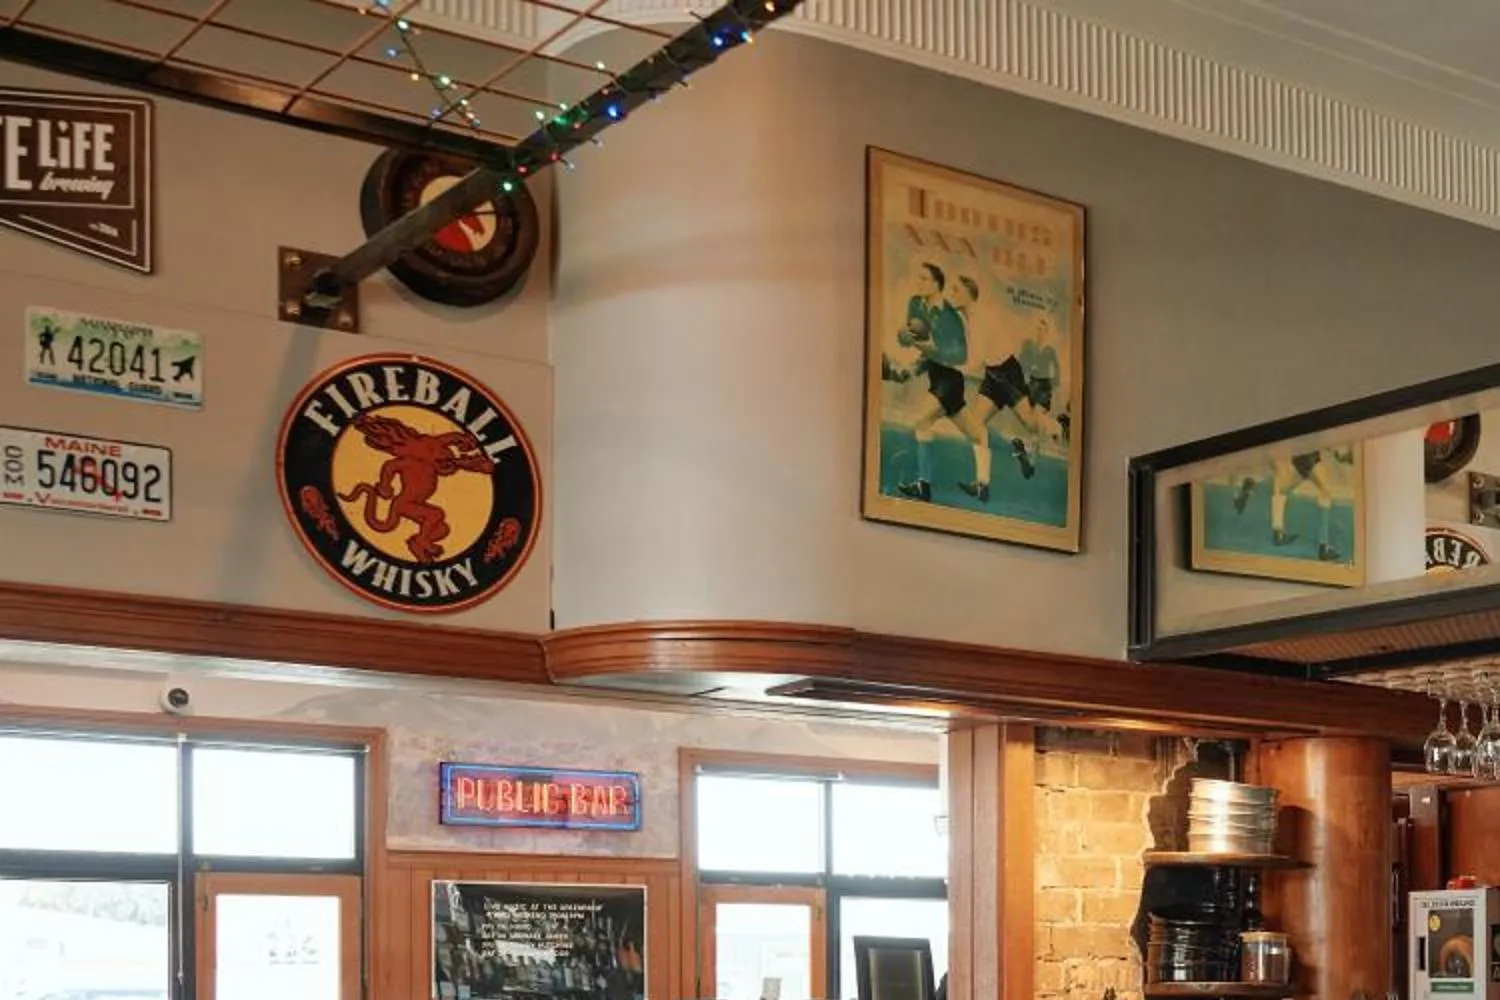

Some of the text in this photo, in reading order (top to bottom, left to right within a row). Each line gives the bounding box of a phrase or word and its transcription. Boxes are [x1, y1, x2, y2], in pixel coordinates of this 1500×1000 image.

[0, 115, 33, 191] E
[38, 171, 115, 201] brewing
[67, 335, 166, 384] 42041
[303, 366, 521, 465] FIREBALL
[44, 436, 123, 458] MAINE
[37, 449, 162, 503] 546092
[340, 539, 480, 598] WHISKY
[456, 776, 629, 816] PUBLIC BAR
